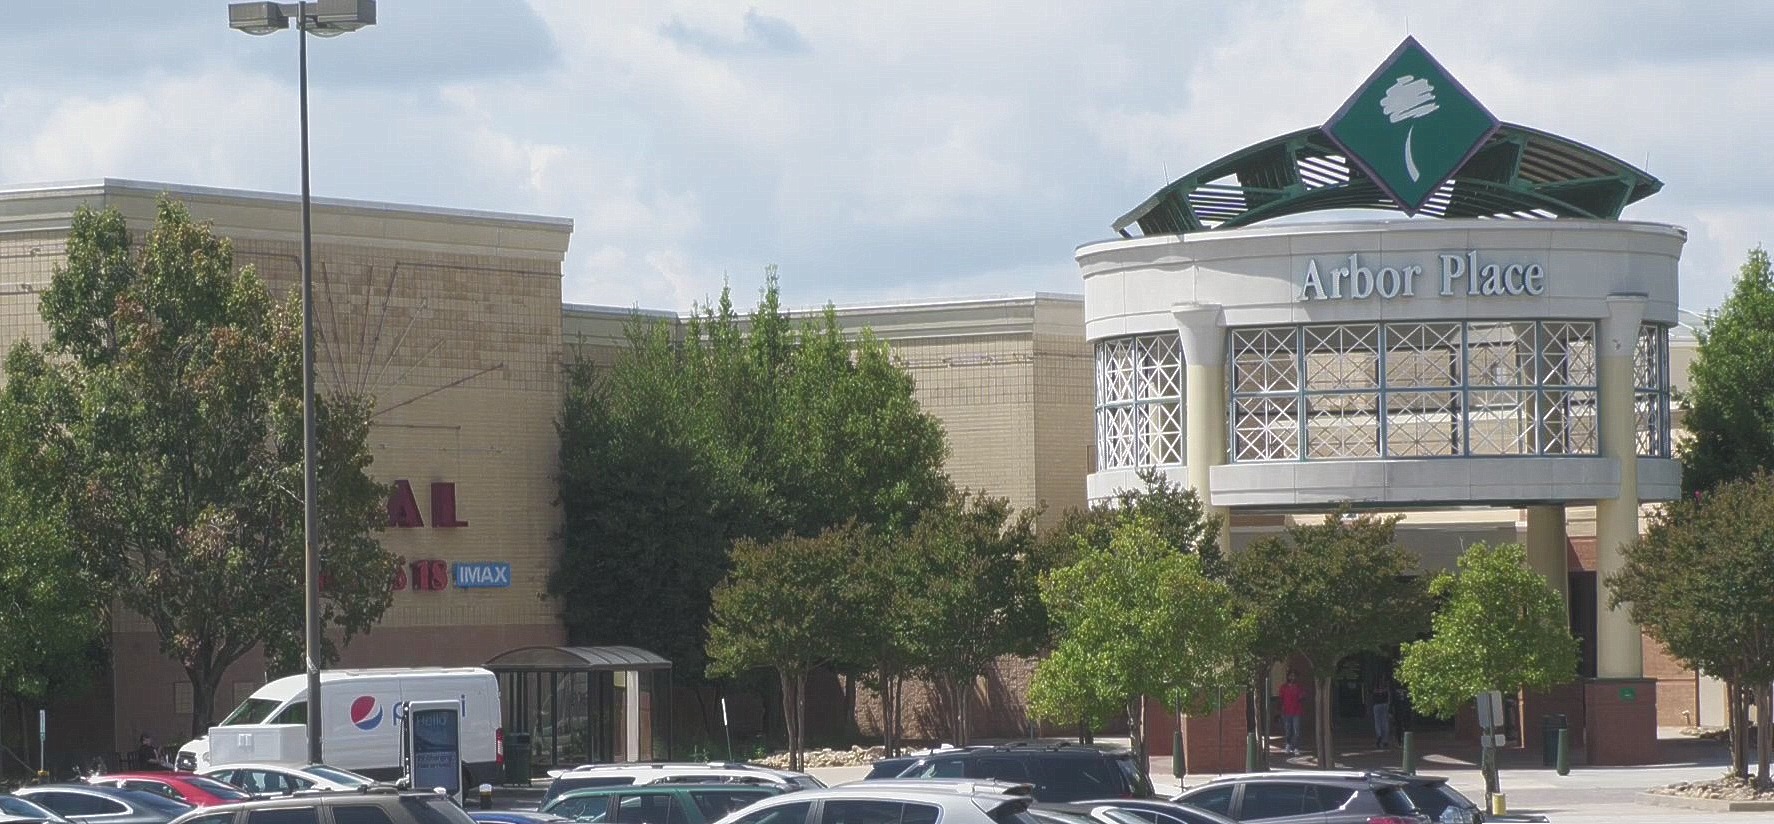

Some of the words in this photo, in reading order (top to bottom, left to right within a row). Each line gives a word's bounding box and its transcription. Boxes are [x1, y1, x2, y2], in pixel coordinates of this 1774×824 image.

[1300, 252, 1422, 301] Arbor
[1439, 250, 1545, 297] Place
[458, 565, 509, 584] IMAX
